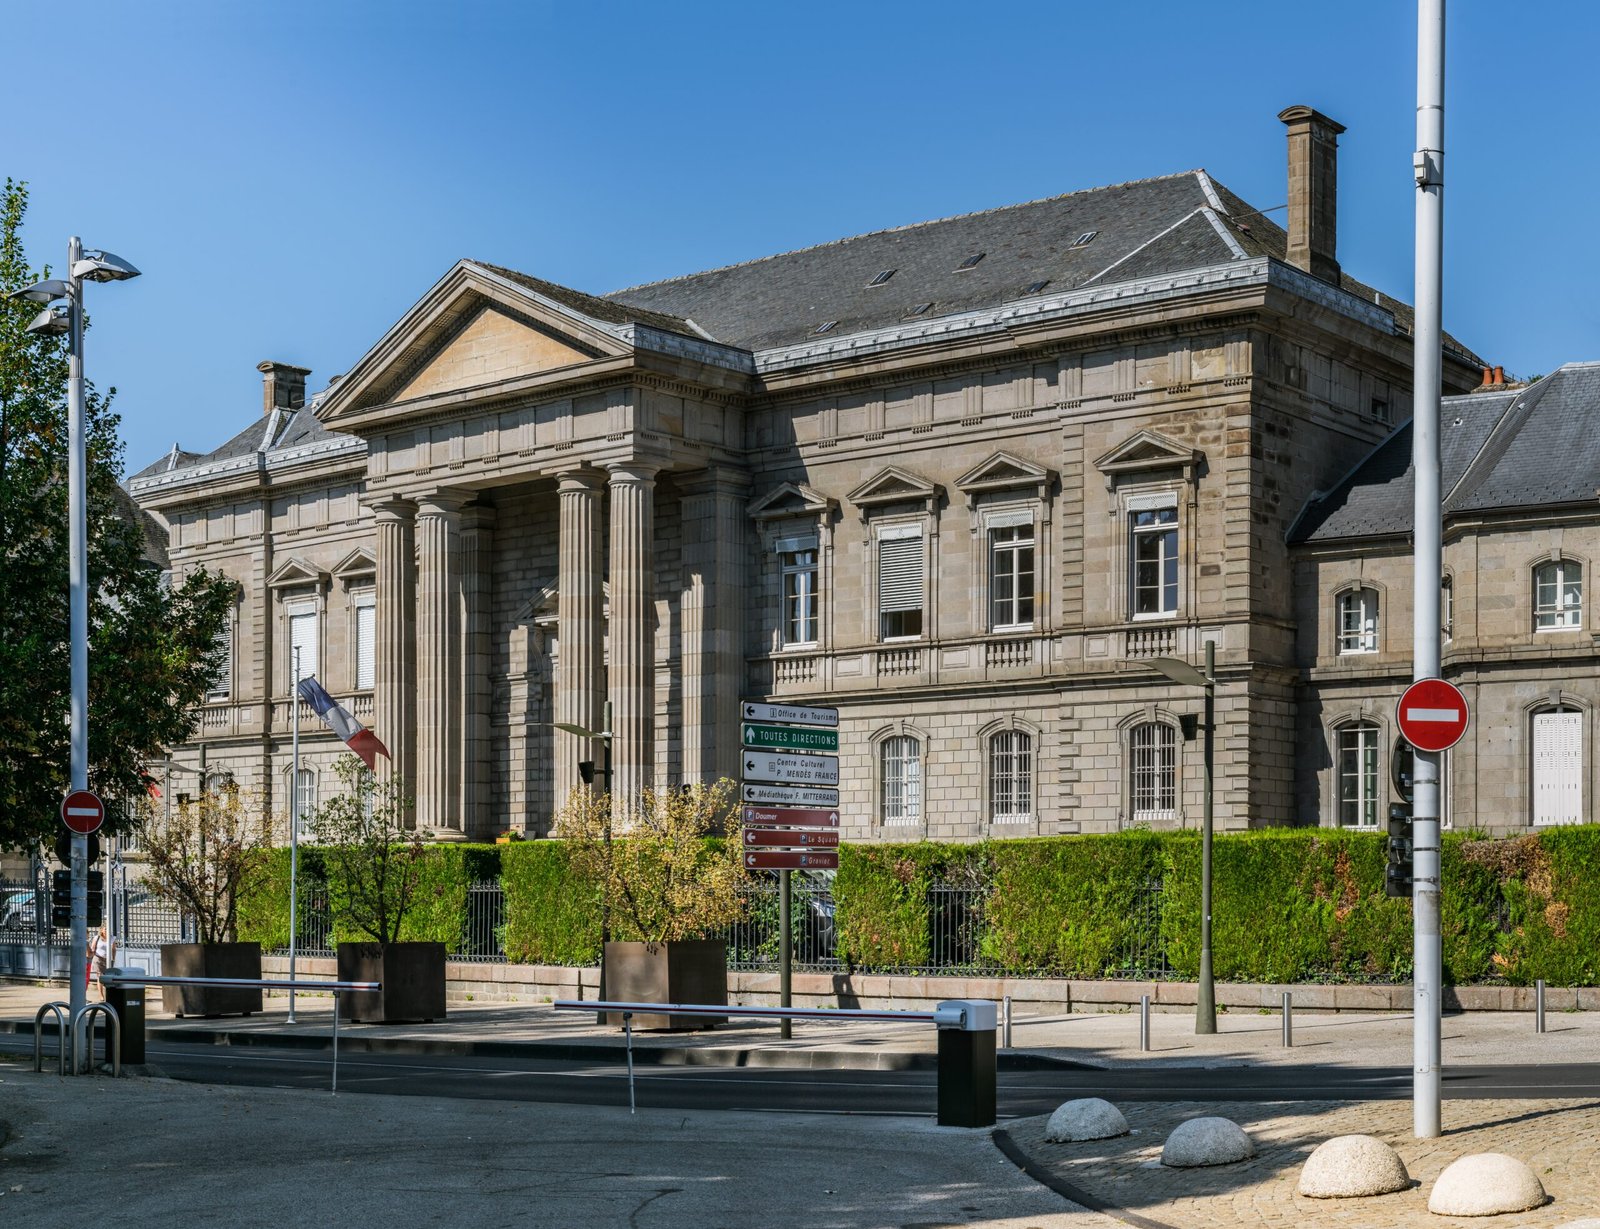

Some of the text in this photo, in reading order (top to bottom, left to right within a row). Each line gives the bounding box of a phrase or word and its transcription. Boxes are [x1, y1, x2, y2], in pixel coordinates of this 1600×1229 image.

[778, 710, 796, 718] Office
[812, 712, 836, 722] Tourisme
[760, 731, 836, 746] TOUTES DIRECTIONS
[776, 758, 825, 768] Centre Culturel
[787, 769, 811, 778] MENDÈS
[814, 772, 836, 780] FRANCE
[758, 790, 793, 800] Médiathèque
[803, 793, 838, 802] MITTERRAND
